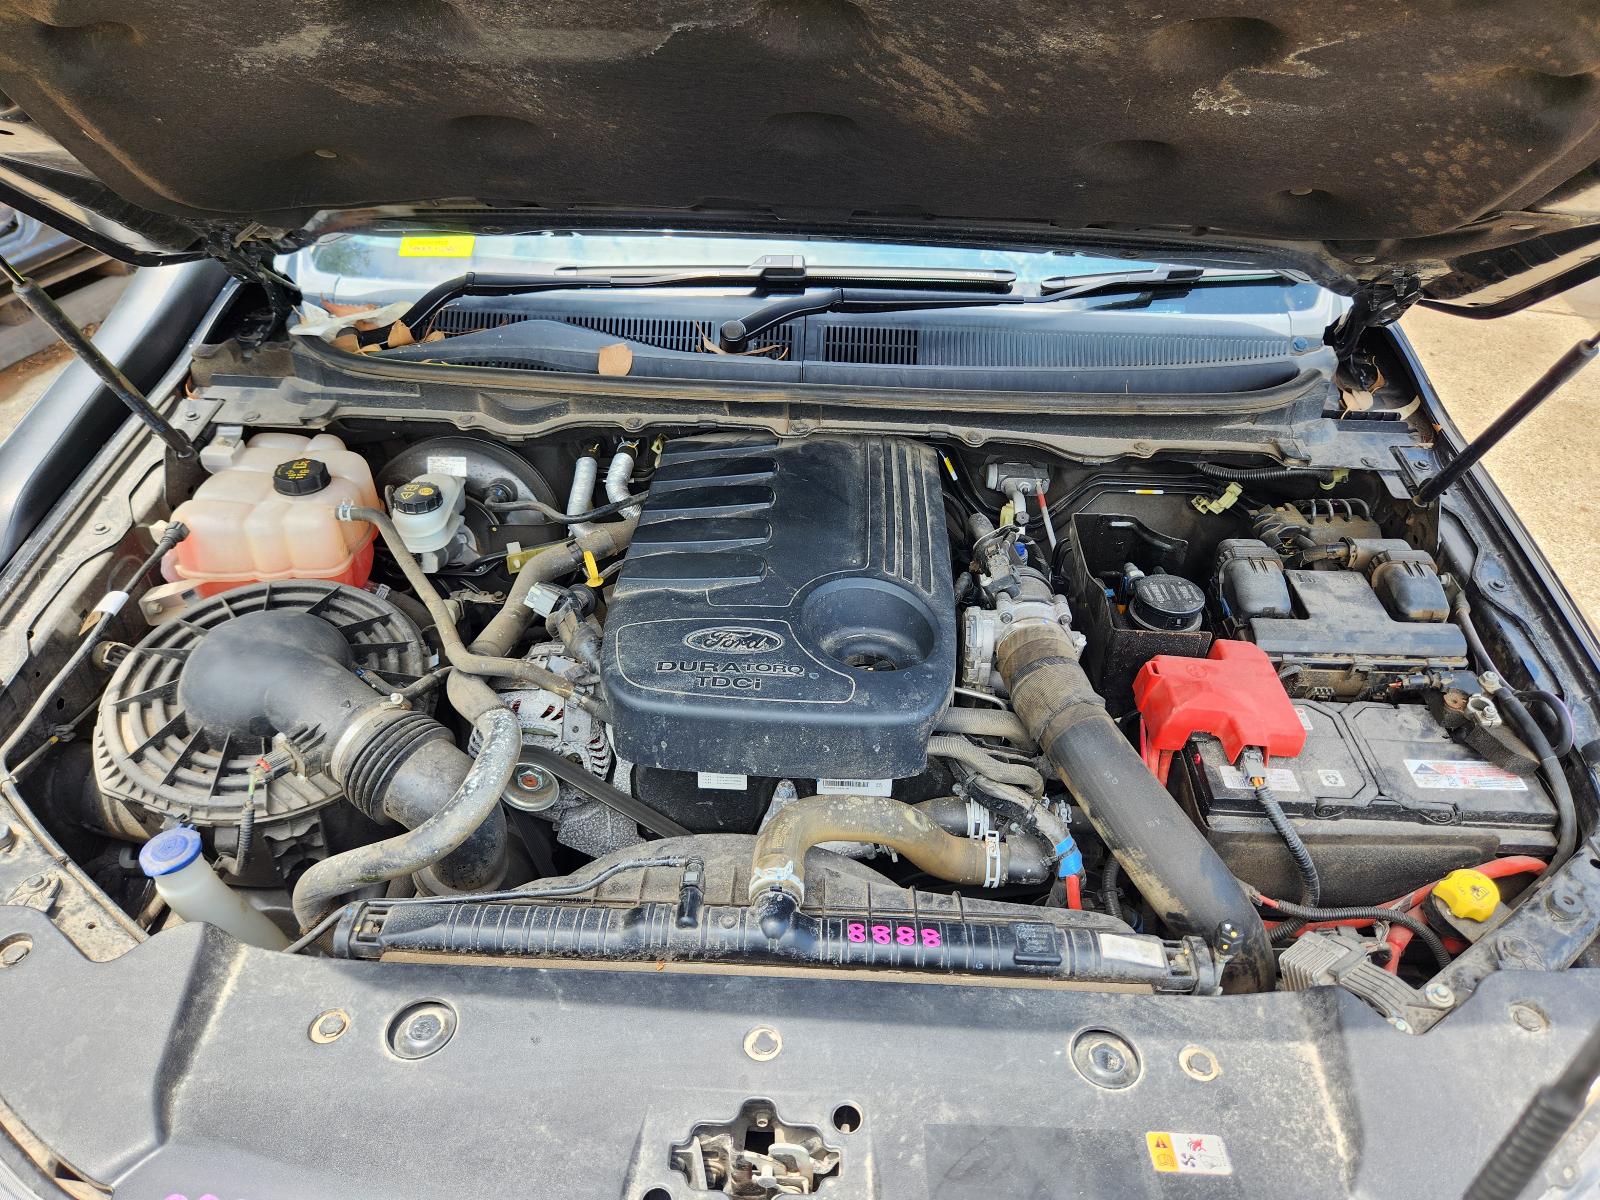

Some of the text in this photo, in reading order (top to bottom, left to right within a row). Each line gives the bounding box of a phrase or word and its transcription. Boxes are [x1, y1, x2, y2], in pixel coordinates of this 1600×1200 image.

[703, 630, 768, 649] Ford
[656, 661, 804, 676] DURATORQ
[697, 676, 761, 690] TDCi
[848, 923, 941, 948] 8888
